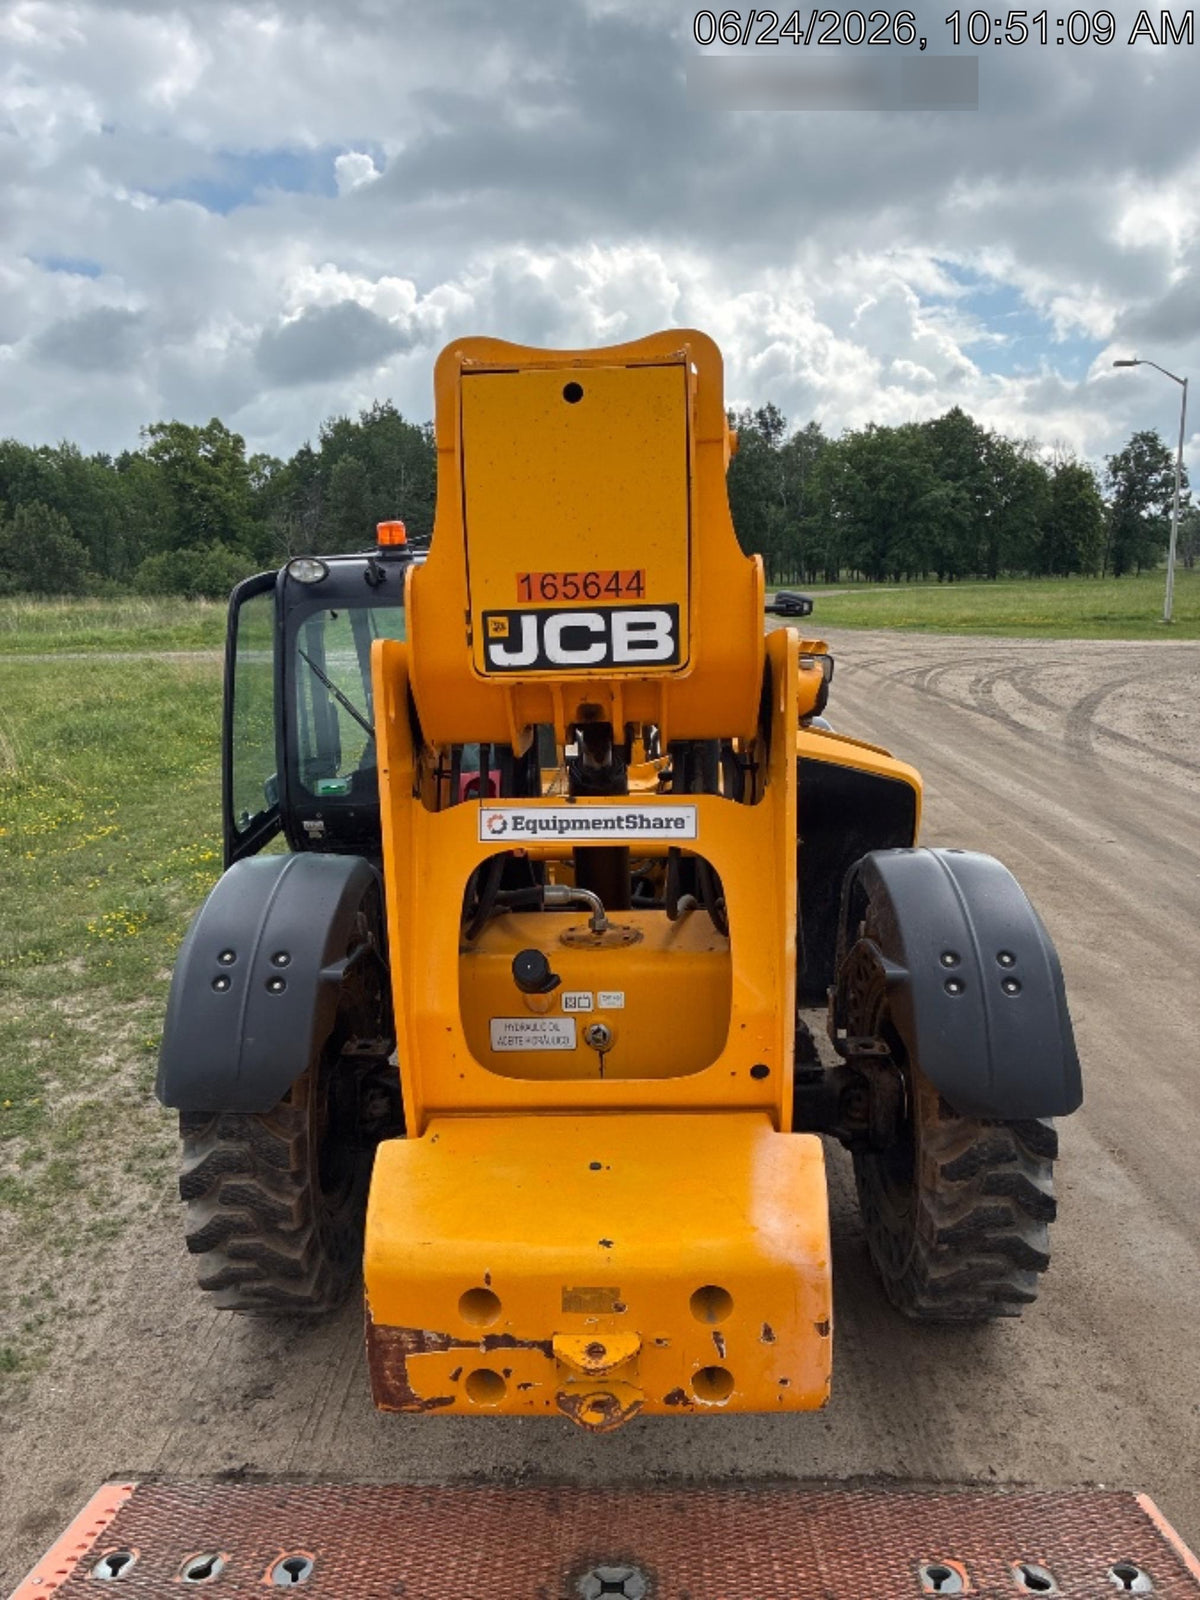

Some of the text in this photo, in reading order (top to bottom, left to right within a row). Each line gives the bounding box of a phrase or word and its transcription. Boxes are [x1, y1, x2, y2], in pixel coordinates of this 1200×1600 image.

[521, 570, 644, 600] 165644
[489, 610, 675, 667] JCB
[511, 814, 685, 834] EquipmentShare
